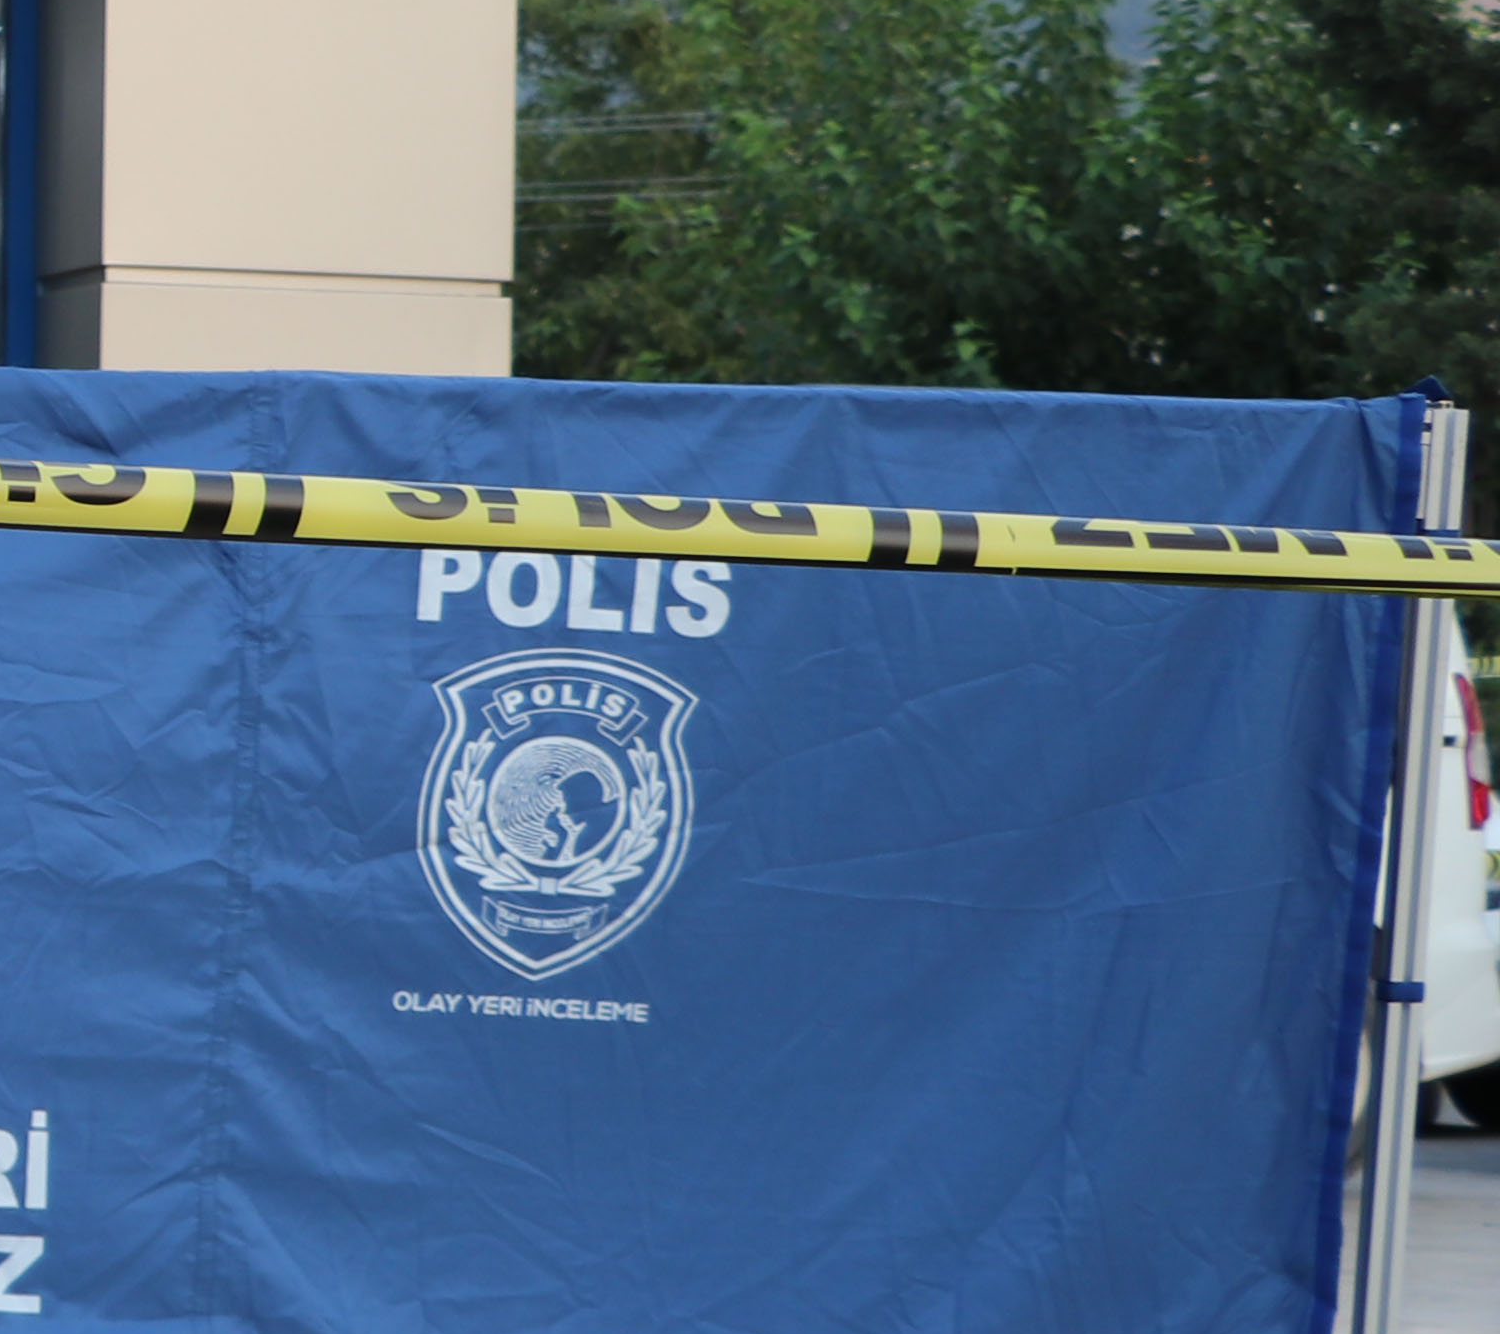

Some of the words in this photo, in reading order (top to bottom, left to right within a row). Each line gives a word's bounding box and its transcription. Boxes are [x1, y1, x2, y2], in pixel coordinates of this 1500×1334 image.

[501, 681, 628, 718] POLİS
[392, 990, 463, 1013] OLAY
[466, 994, 522, 1017] YERİ
[525, 995, 650, 1023] İNCELEME
